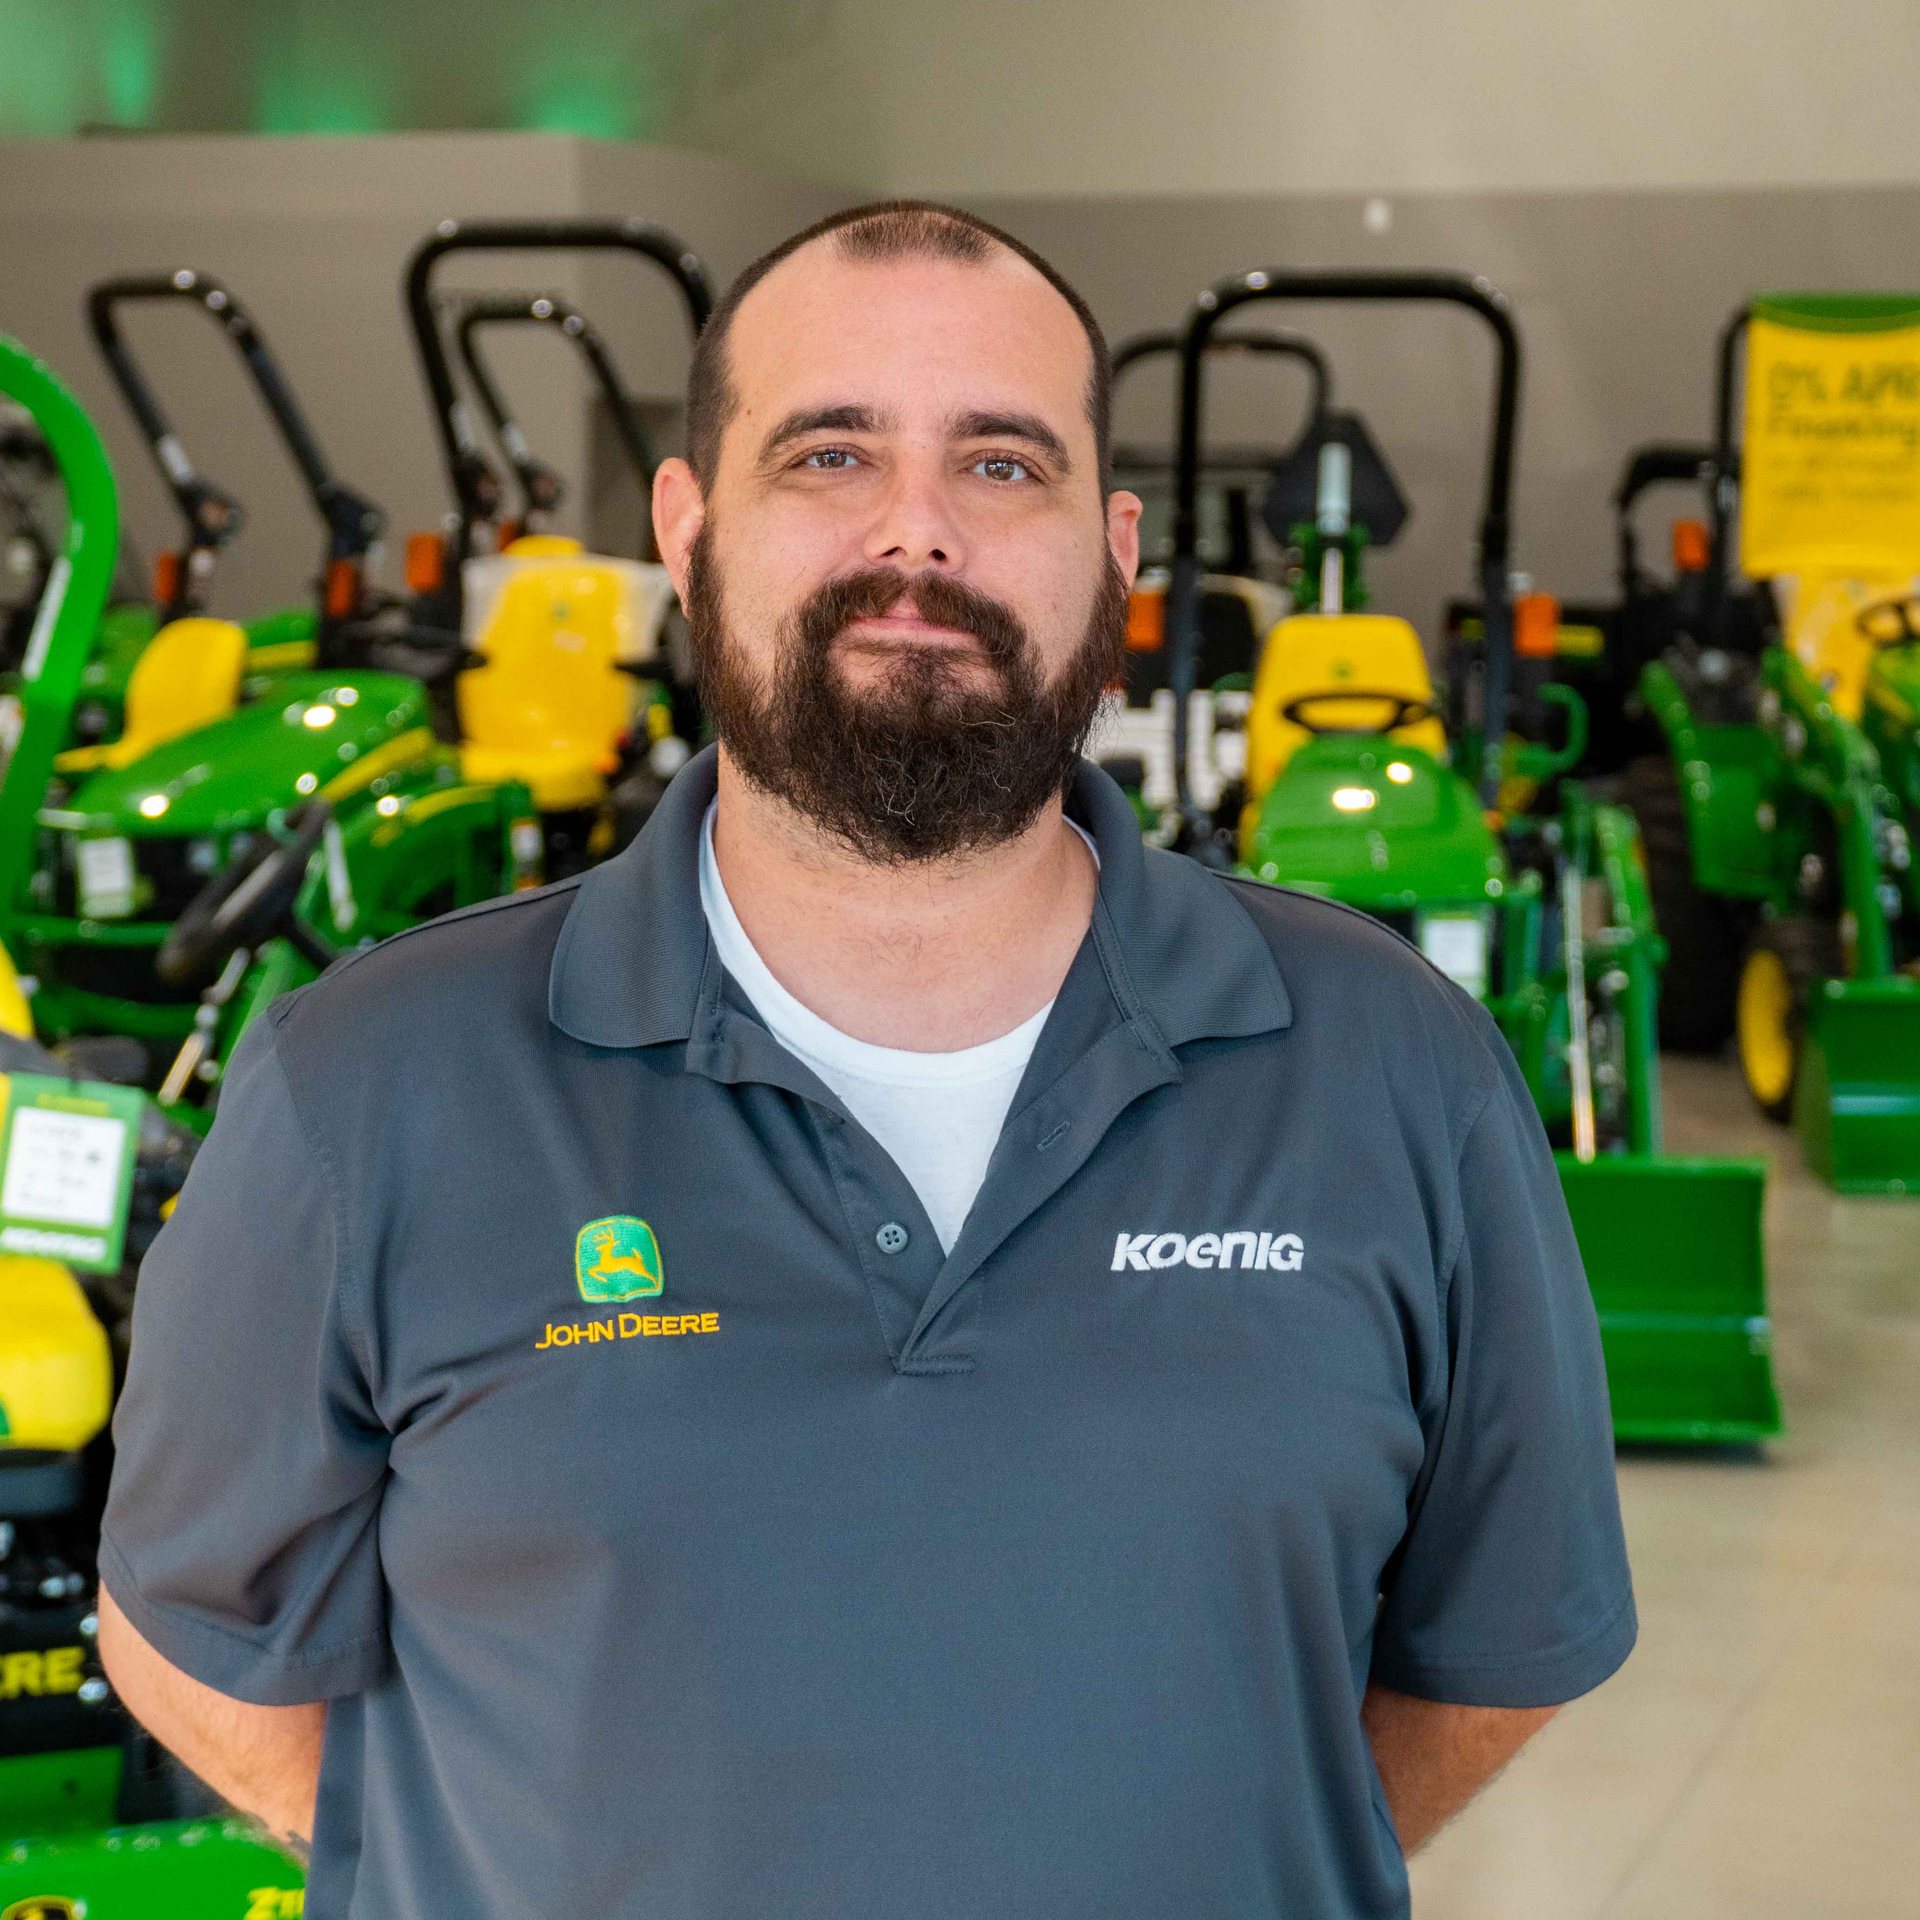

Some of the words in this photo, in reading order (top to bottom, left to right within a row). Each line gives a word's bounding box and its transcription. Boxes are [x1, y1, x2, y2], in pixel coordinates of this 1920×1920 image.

[535, 1319, 614, 1349] JOHN
[618, 1312, 720, 1339] DEERE
[0, 1647, 85, 1699] RE
